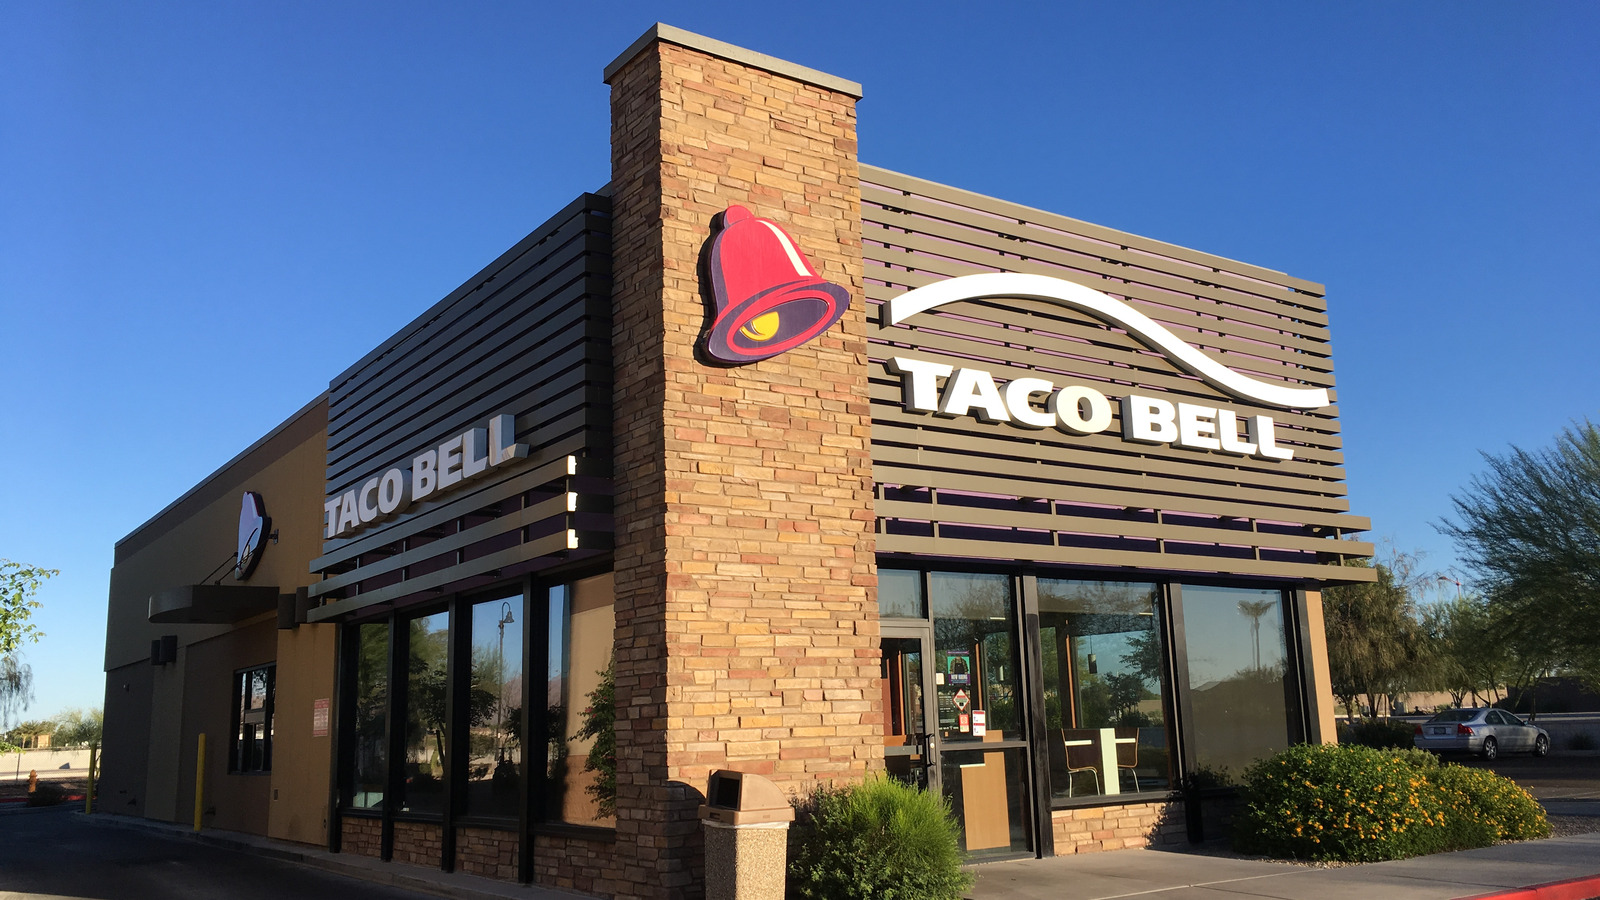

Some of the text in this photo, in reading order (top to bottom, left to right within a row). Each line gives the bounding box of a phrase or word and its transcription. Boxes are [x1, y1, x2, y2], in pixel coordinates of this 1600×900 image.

[890, 357, 1295, 461] TACO BELL
[324, 414, 530, 539] TACO BELL
